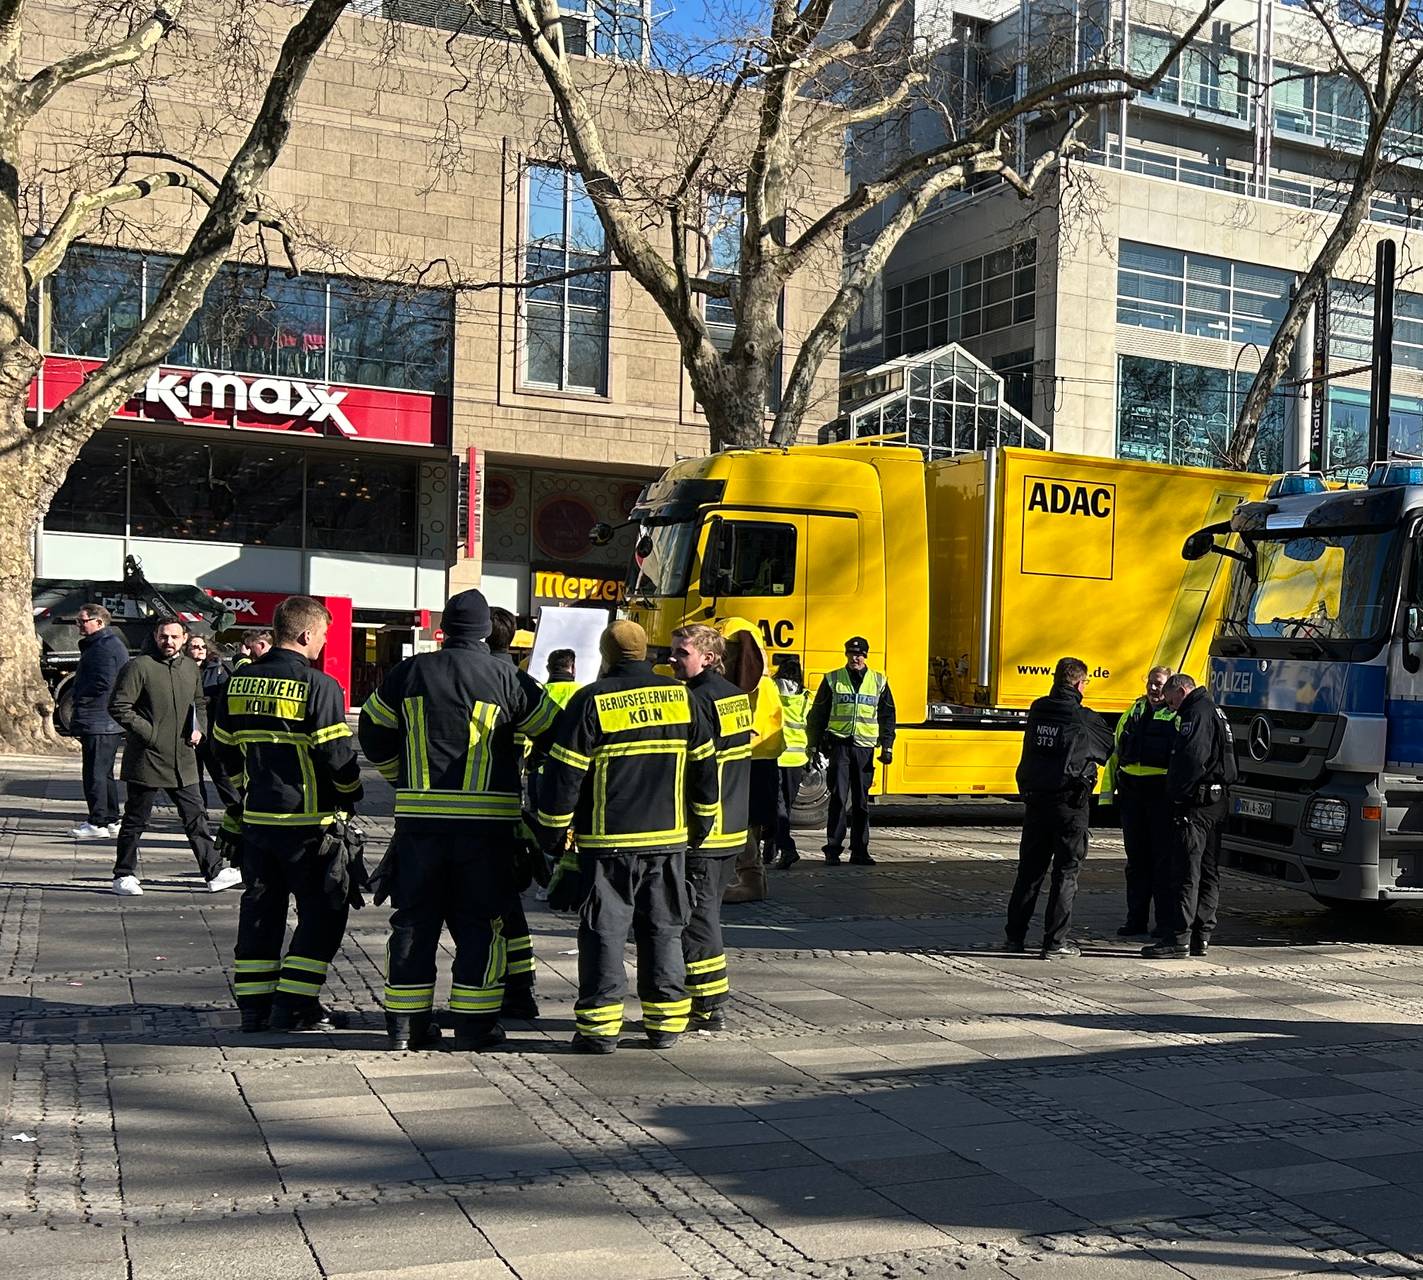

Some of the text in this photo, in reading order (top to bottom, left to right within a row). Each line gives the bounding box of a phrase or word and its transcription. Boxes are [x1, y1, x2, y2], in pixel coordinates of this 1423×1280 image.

[1028, 482, 1111, 518] ADAC
[152, 597, 172, 617] GERG
[757, 619, 795, 648] AC
[229, 679, 306, 699] FEUERWEHR
[1210, 671, 1254, 694] POLIZEI
[245, 697, 277, 715] KÖLN
[837, 694, 875, 705] POLIZEI
[628, 707, 663, 724] KÖLN
[1036, 725, 1059, 737] NRW
[1037, 736, 1054, 748] 3T3
